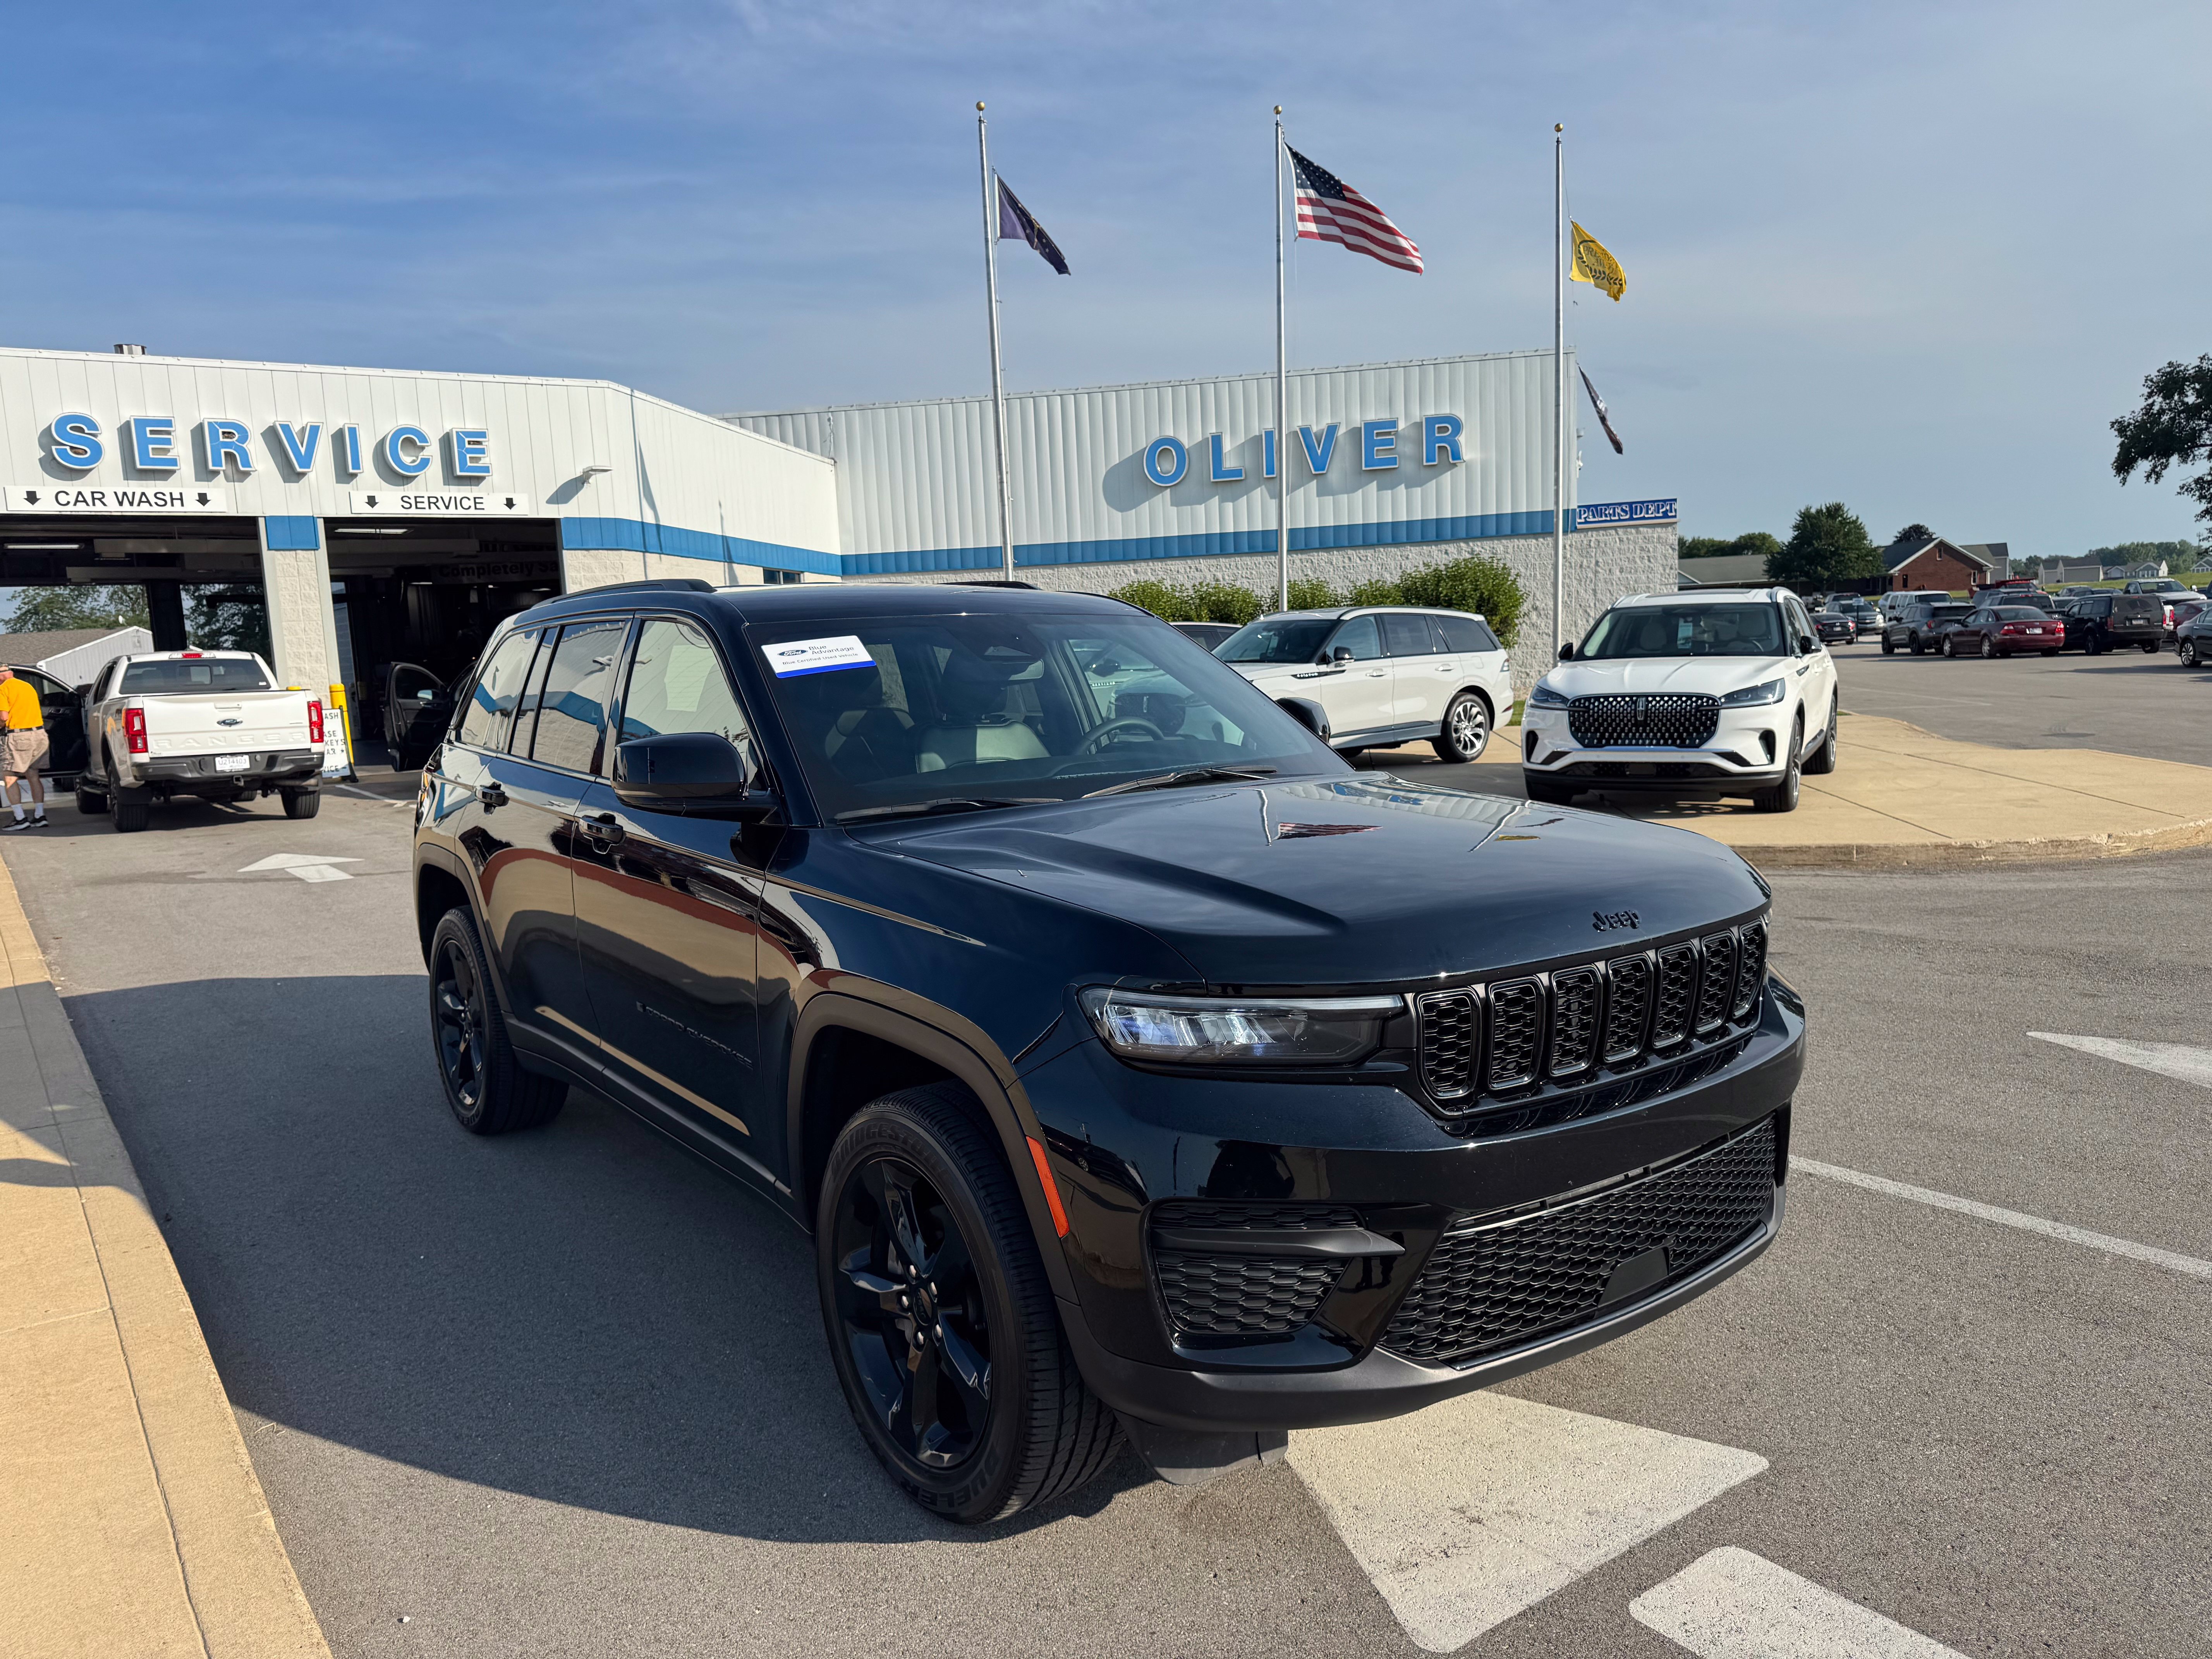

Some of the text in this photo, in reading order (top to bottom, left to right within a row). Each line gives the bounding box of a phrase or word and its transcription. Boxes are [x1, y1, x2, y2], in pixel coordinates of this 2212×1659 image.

[50, 412, 493, 477] SERVICE
[1143, 413, 1466, 487] OLIVER
[54, 491, 184, 507] CAR WASH
[400, 496, 485, 510] SERVICE
[1577, 502, 1676, 522] PARTS DEPT
[439, 562, 558, 579] Completely Sa
[812, 646, 854, 655] Advantage
[154, 732, 306, 749] RANGER
[1592, 910, 1642, 931] Jeep
